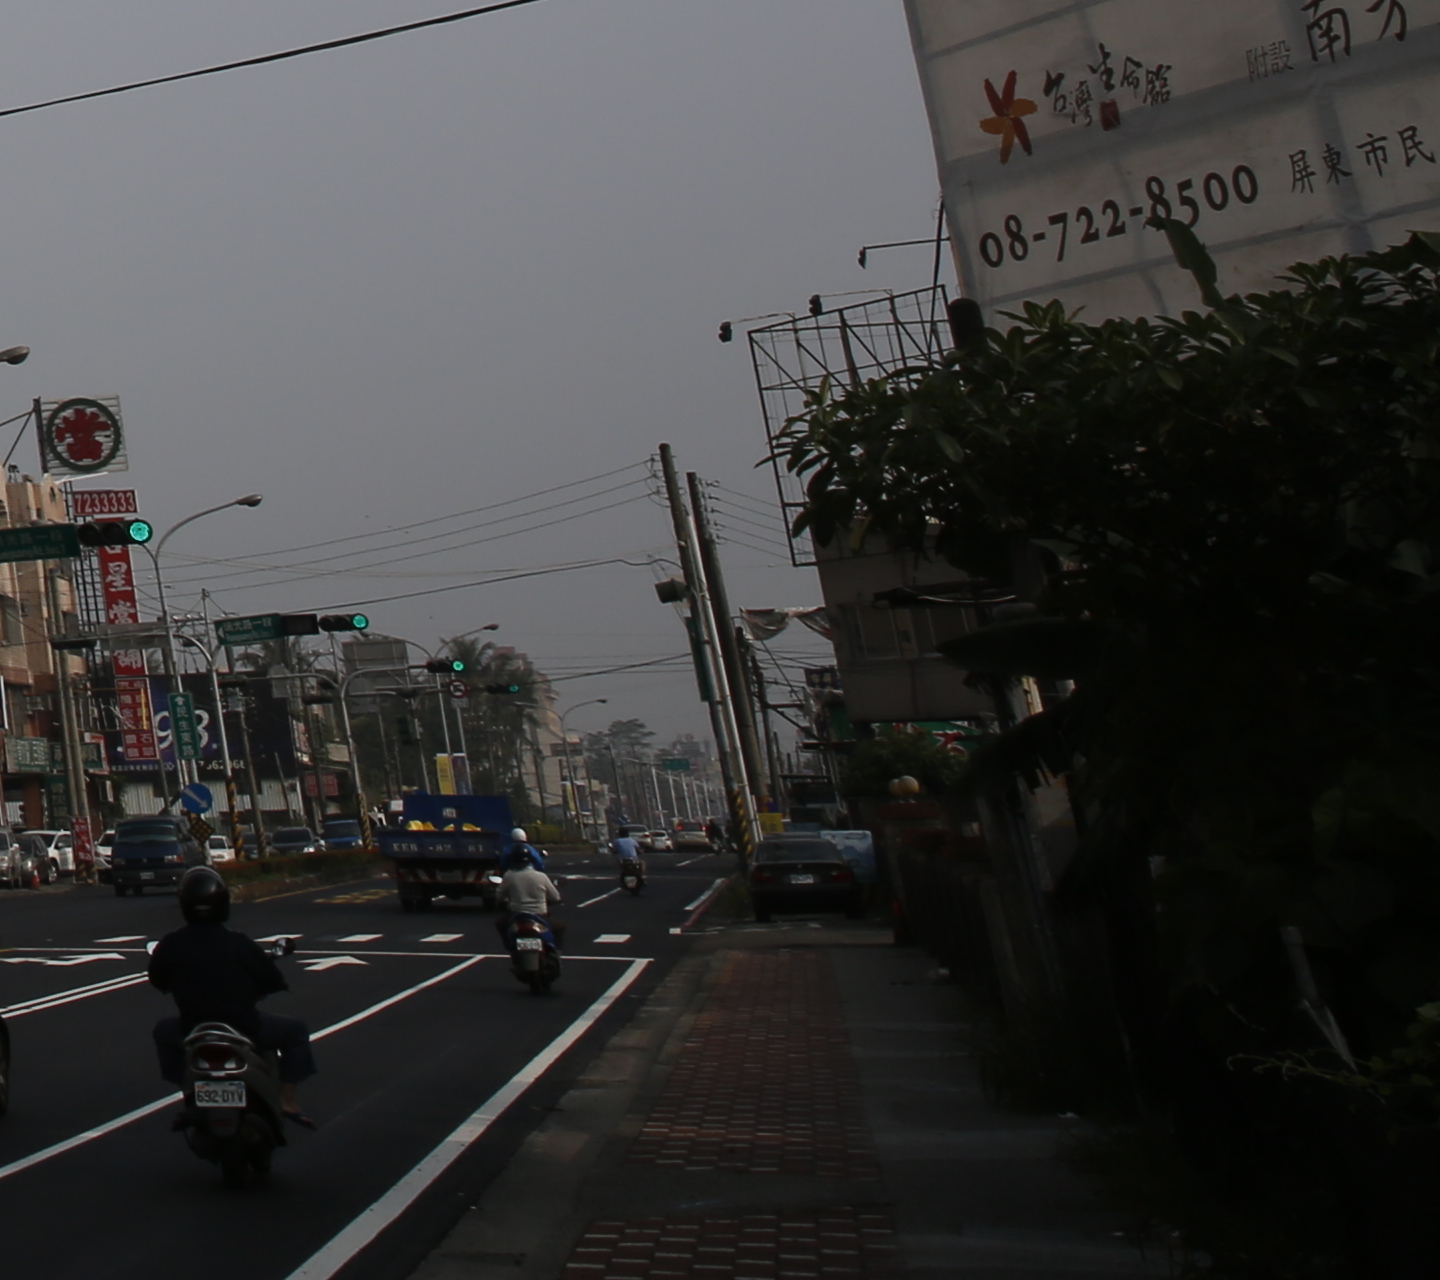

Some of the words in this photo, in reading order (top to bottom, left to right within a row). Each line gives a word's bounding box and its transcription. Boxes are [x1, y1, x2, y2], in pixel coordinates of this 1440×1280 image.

[1246, 41, 1294, 82] 附設
[1288, 126, 1436, 195] 屏東市民
[980, 165, 1259, 269] 08-722-8500
[75, 492, 136, 513] 7233333
[196, 1088, 246, 1104] 692-DYV
